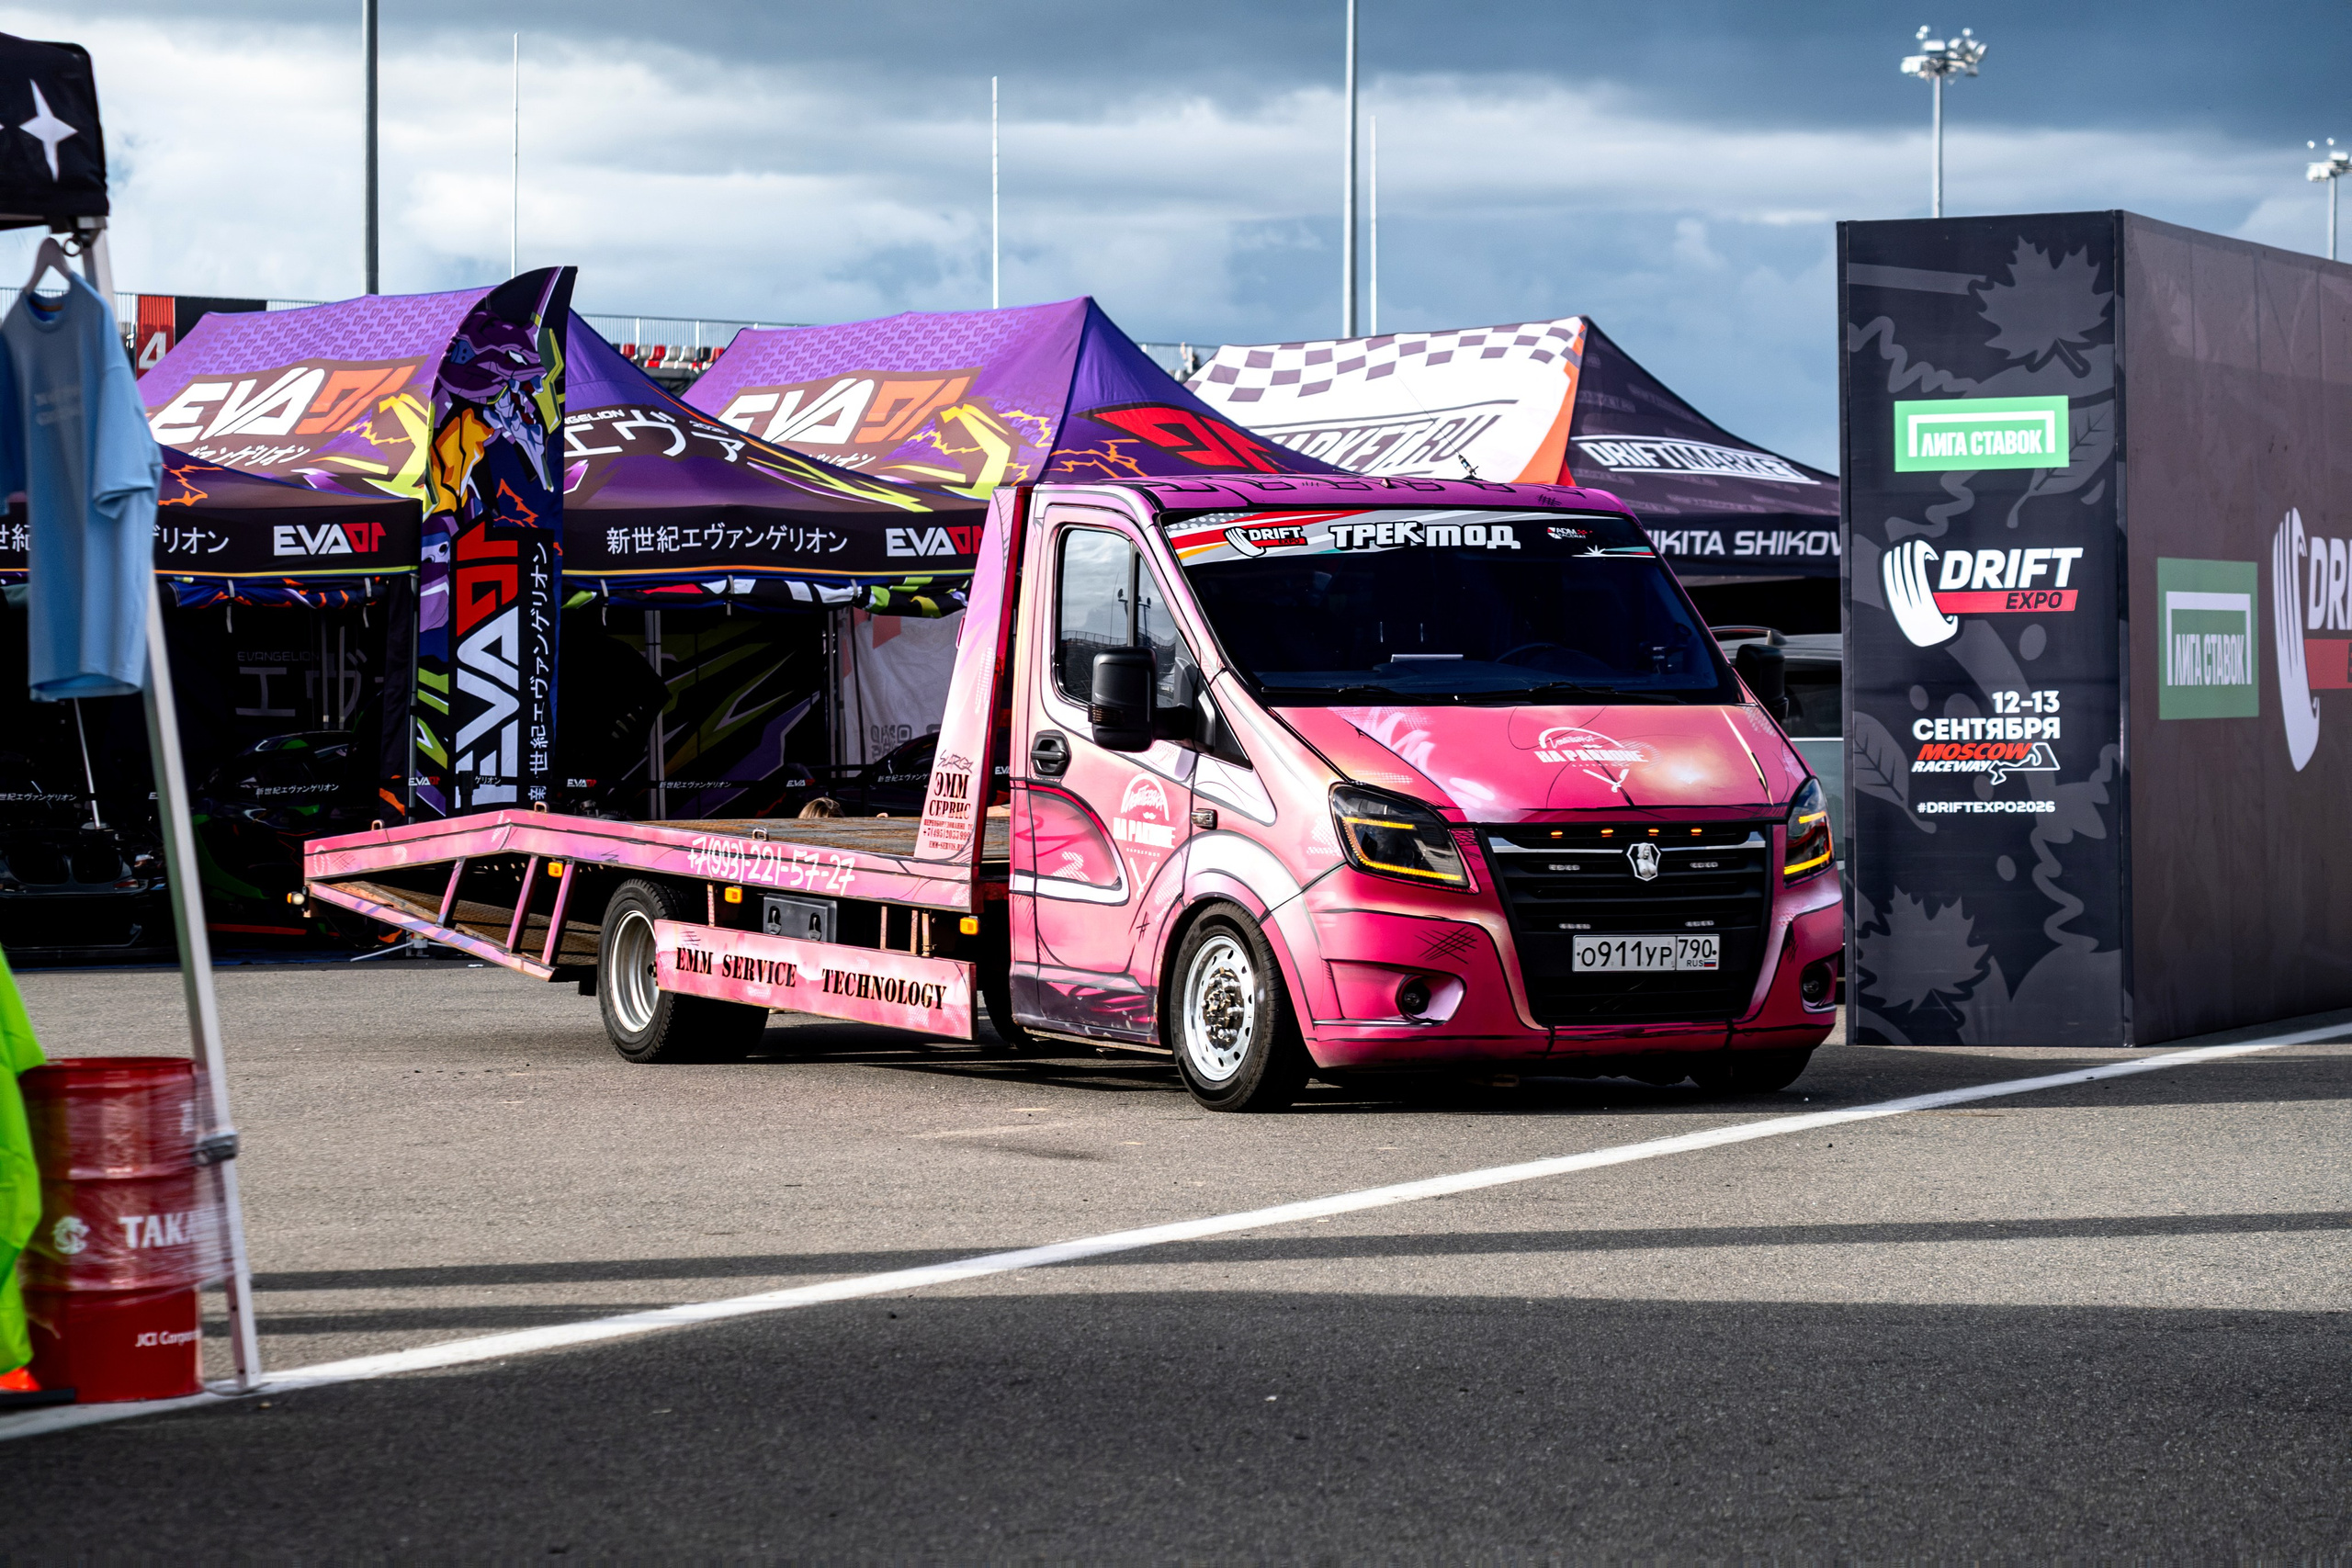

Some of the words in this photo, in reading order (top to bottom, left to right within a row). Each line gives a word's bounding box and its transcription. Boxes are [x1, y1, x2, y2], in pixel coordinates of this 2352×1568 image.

[1921, 432, 1968, 457] ЛИГА
[1970, 429, 2042, 456] СТАВОК
[606, 523, 848, 555] 新世紀エヴァンゲリオン
[1249, 526, 1303, 541] DRIFT
[1278, 537, 1301, 546] EXPO
[1648, 529, 1725, 555] IKITA
[1939, 547, 2084, 590] DRIFT
[2005, 591, 2064, 610] EXPO
[2204, 634, 2245, 686] СТАВОК
[1992, 690, 2061, 714] 12-13
[1912, 716, 2061, 740] СЕНТЯБРЯ
[1917, 742, 2033, 761] MOSCOW
[1911, 760, 1993, 773] RACEWAY
[1917, 801, 2056, 813] #DRIFTEXPO2026
[1678, 939, 1713, 959] 790
[1686, 959, 1703, 967] RUS
[675, 946, 713, 976] EMM
[721, 953, 797, 988] SERVICE
[821, 967, 947, 1010] TECHNOLOGY
